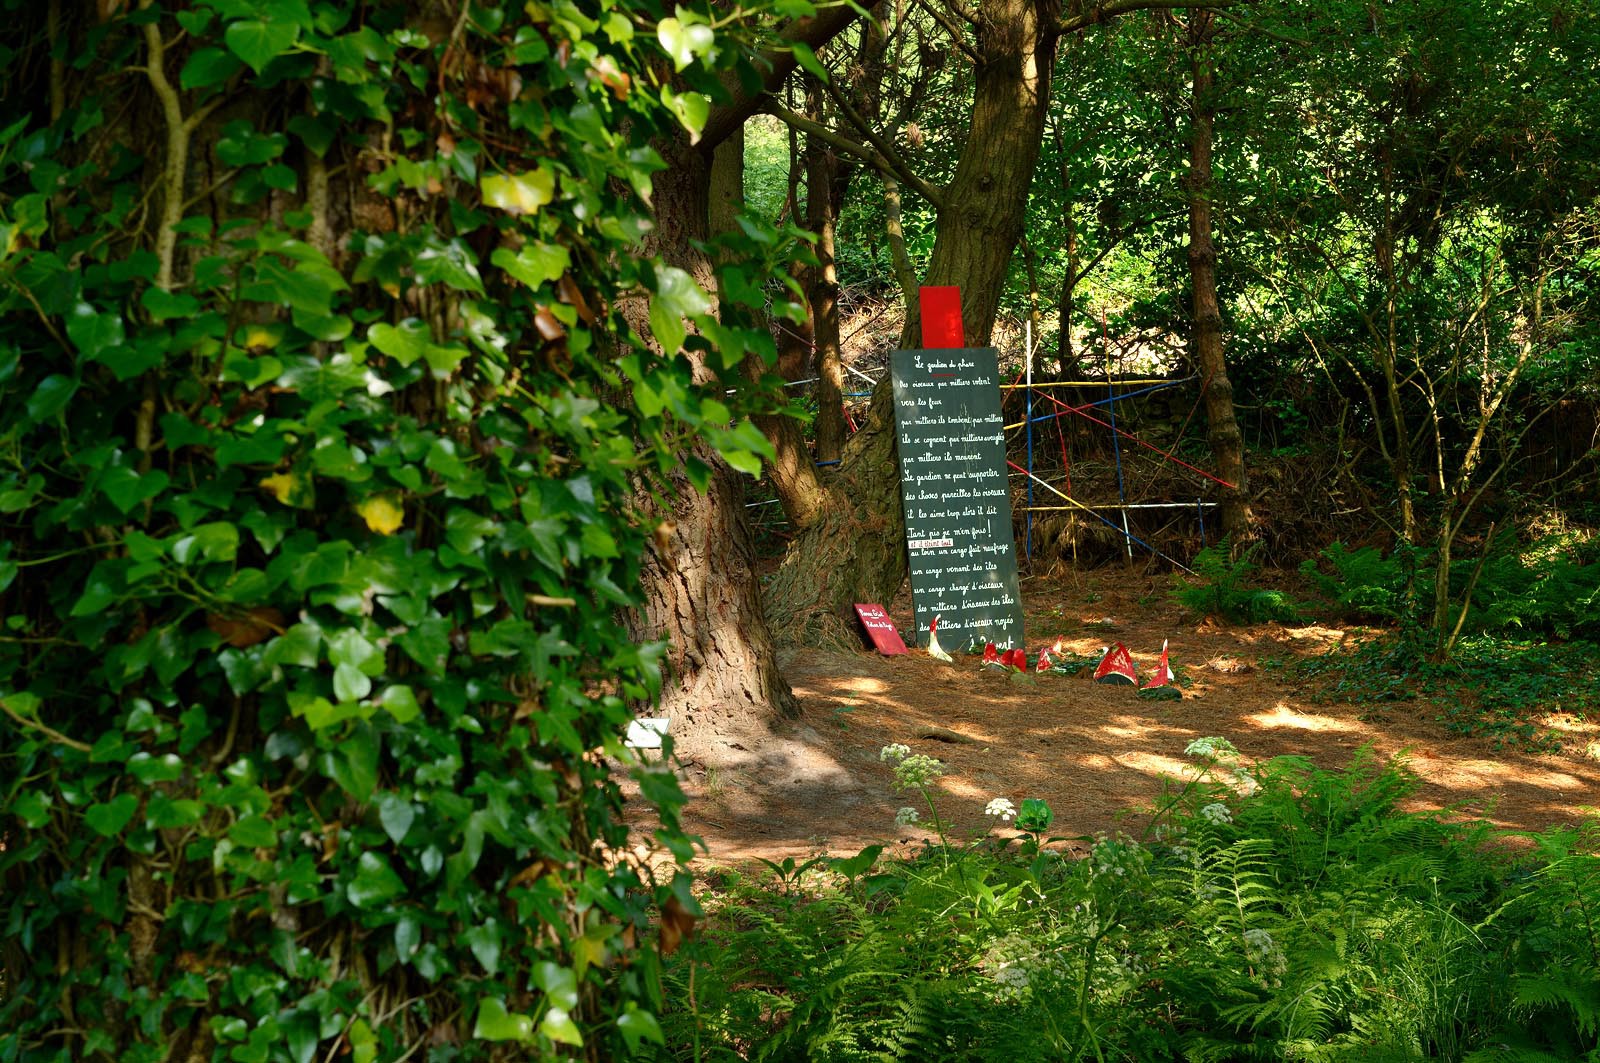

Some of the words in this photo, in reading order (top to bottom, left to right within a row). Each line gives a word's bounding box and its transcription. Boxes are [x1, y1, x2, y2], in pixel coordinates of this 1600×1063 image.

[914, 355, 924, 369] Le
[957, 359, 974, 370] phare
[972, 377, 991, 385] volent
[929, 398, 942, 409] feux
[901, 420, 911, 429] par
[915, 416, 936, 424] milliers
[972, 418, 983, 428] par
[984, 414, 1003, 422] milliers
[902, 434, 910, 444] ils
[924, 436, 946, 448] cognent
[949, 437, 959, 447] par
[903, 458, 914, 467] par
[918, 452, 941, 462] milliers
[953, 472, 966, 482] peut
[969, 468, 999, 482] supporter
[918, 490, 938, 500] choses
[941, 489, 971, 502] pareilles
[982, 488, 1005, 496] oiseaux
[907, 509, 914, 518] il
[919, 509, 927, 518] les
[947, 509, 960, 520] trop
[962, 507, 975, 516] alors
[977, 506, 983, 515] il
[986, 506, 997, 515] dit
[929, 528, 940, 540] pis
[942, 528, 950, 539] je
[951, 548, 967, 558] cargo
[968, 544, 981, 557] fait
[983, 543, 1008, 555] naufrage
[926, 568, 942, 578] cargo
[947, 565, 970, 573] venant
[985, 562, 997, 570] îles
[928, 587, 945, 597] cargo
[950, 582, 970, 595] chargé
[972, 582, 1004, 590] d'oiseaux
[918, 604, 927, 612] des
[931, 602, 957, 612] milliers
[962, 600, 990, 609] d'oiseaux
[991, 597, 1000, 606] des
[1001, 594, 1014, 604] îles
[920, 622, 930, 631] des
[965, 619, 993, 628] d'oiseaux
[995, 614, 1013, 630] noyés
